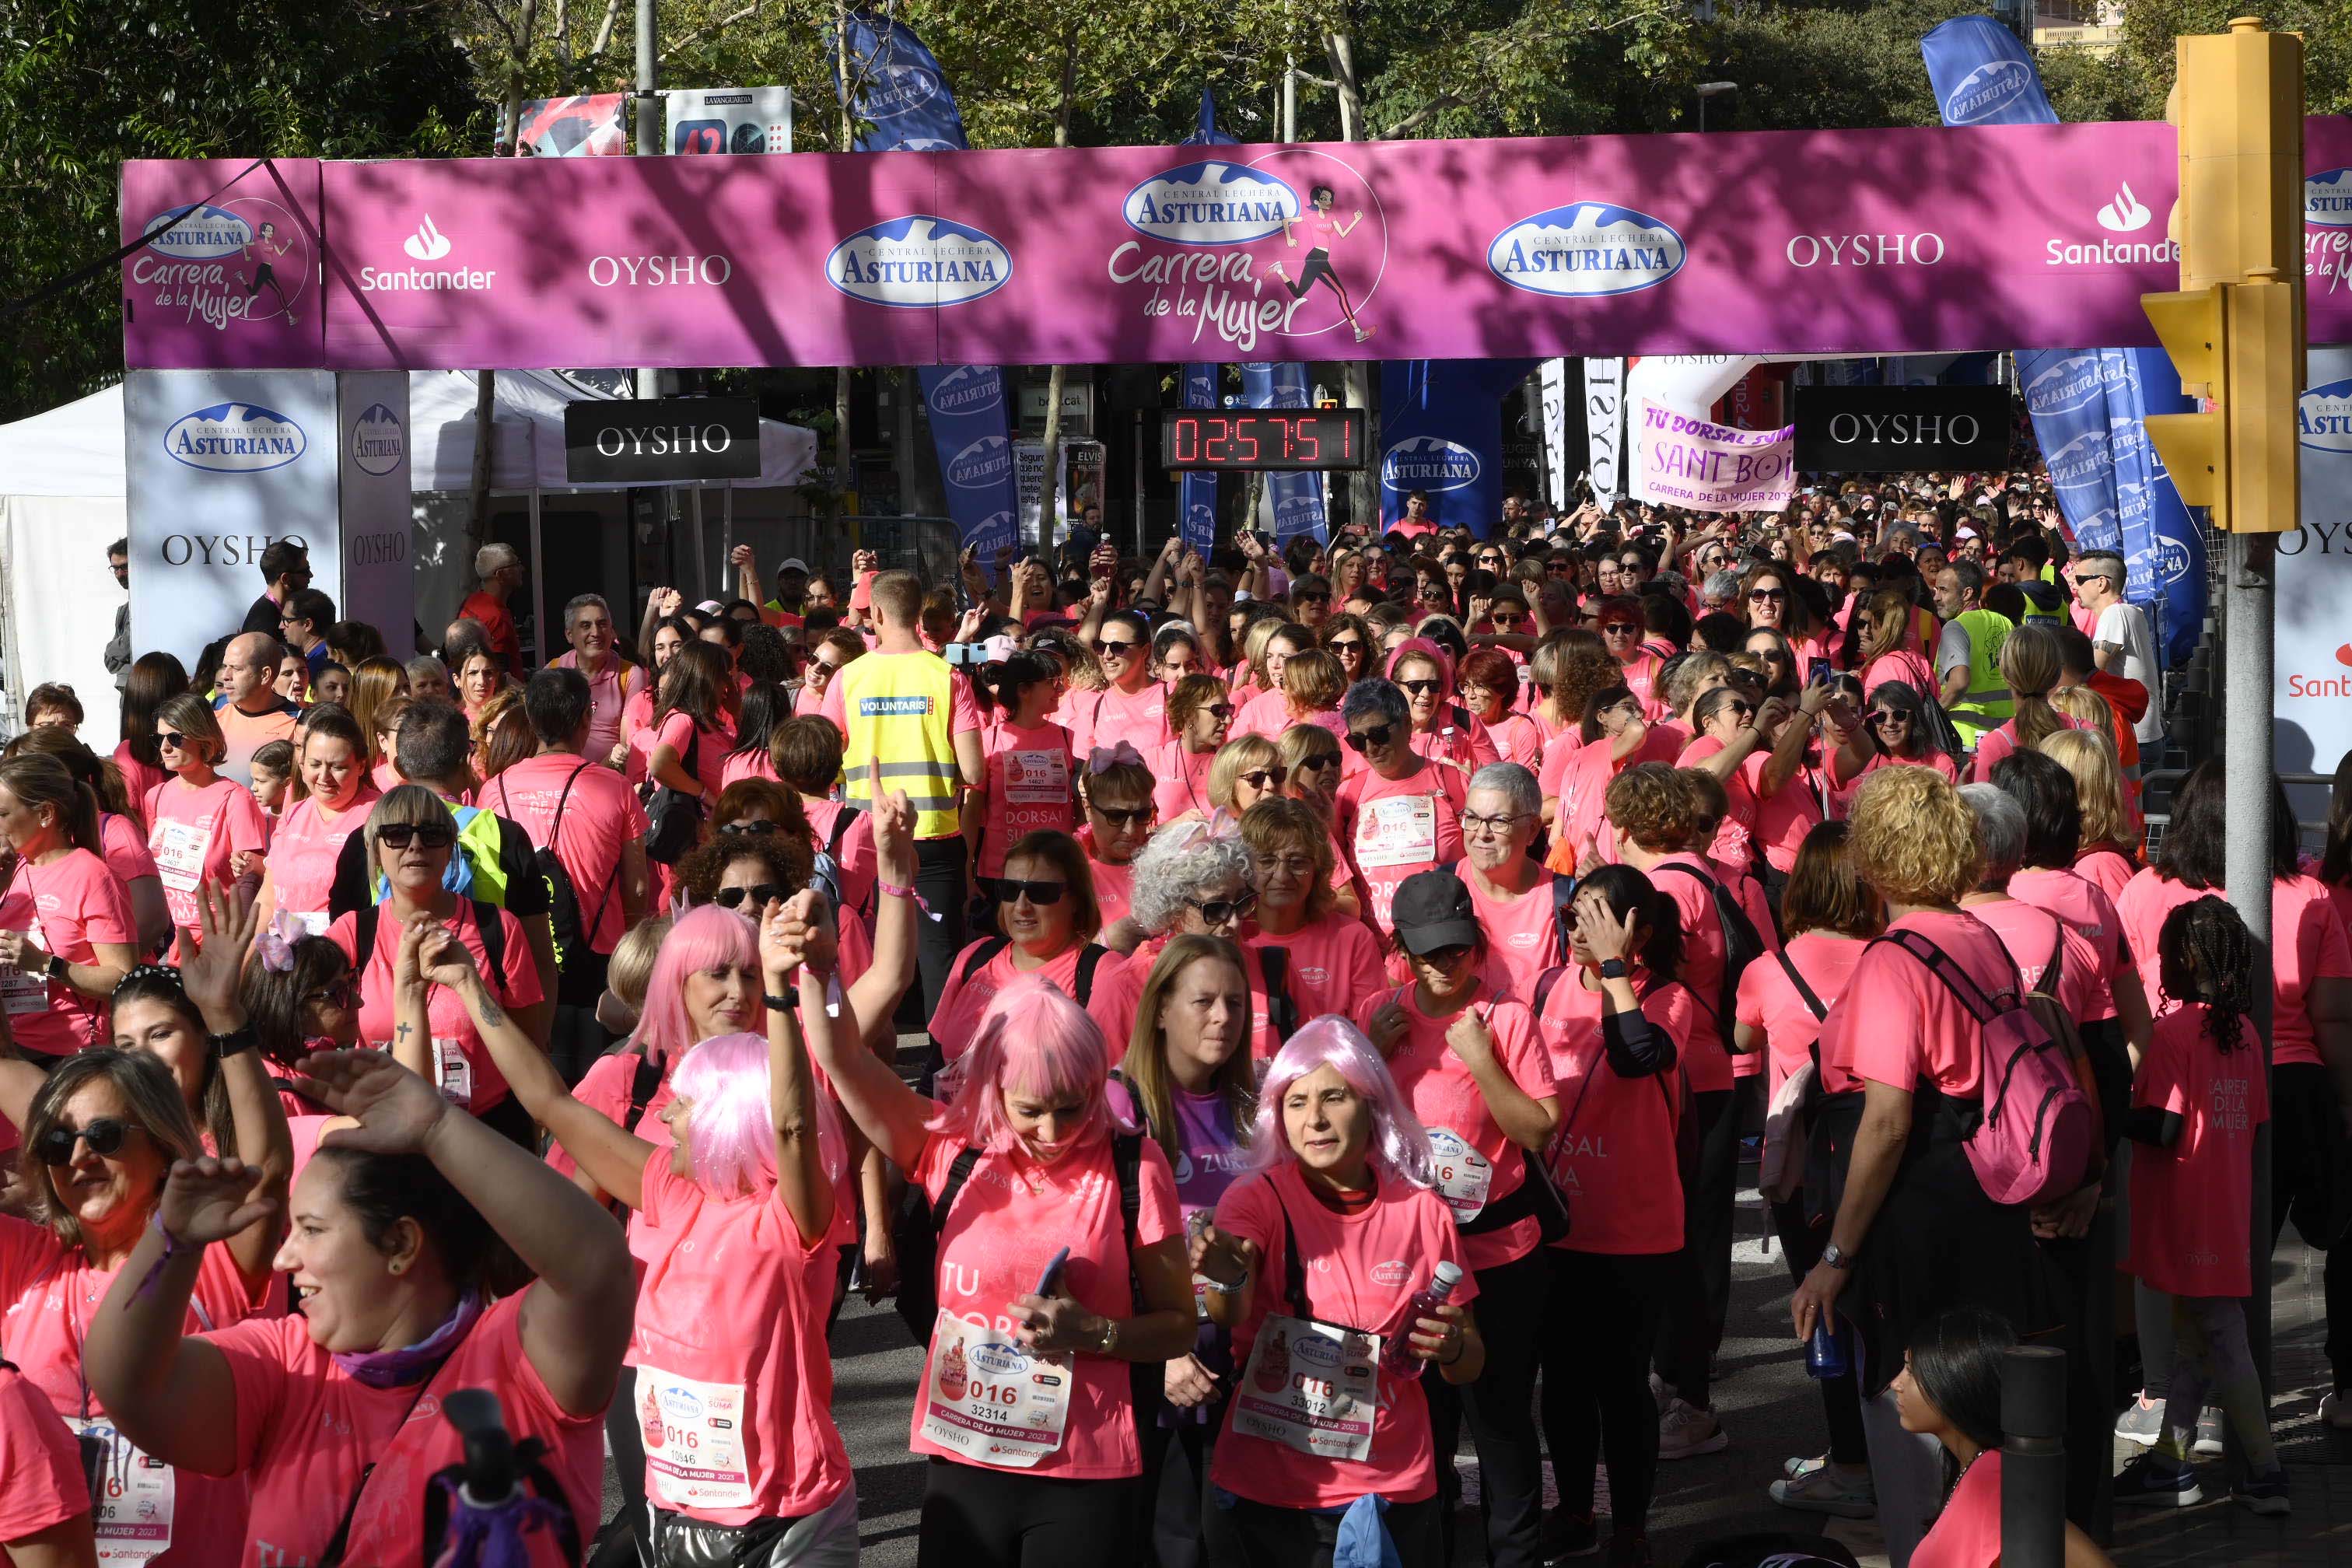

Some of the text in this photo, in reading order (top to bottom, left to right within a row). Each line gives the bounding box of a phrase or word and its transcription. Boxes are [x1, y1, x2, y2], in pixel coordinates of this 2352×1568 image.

[714, 95, 751, 104] VANGUARDIA
[1164, 187, 1281, 199] CENTRAL LECHERA
[1136, 194, 1284, 226] ASTURIANA
[152, 224, 243, 245] ASTURIANA
[1533, 233, 1664, 245] CENTRAL LECHERA
[869, 245, 992, 257] CENTRAL LECHERA
[1503, 237, 1671, 273] ASTURIANA
[1787, 233, 1944, 267] OYSHO
[2046, 238, 2181, 265] Santande
[132, 256, 223, 285] Carrera
[588, 255, 731, 287] OYSHO
[840, 256, 998, 284] ASTURIANA
[1108, 240, 1252, 284] Carrera
[2319, 254, 2332, 276] la
[361, 265, 496, 292] Santander
[156, 282, 259, 331] de la Mujer
[1143, 279, 1307, 352] de la Mujer
[1646, 408, 1669, 429] TU
[1671, 415, 1745, 445] DORSAL
[1829, 413, 1979, 445] OYSHO
[175, 429, 296, 456] ASTURIANA
[355, 432, 401, 457] ASTURIANA
[596, 424, 730, 456] OYSHO
[1176, 418, 1349, 460] 02:57:51
[1078, 452, 1101, 462] ELVIS
[1651, 441, 1728, 482] SANT
[1020, 464, 1032, 474] que
[1385, 459, 1472, 480] ASTURIANA
[1020, 495, 1034, 504] este
[1649, 481, 1793, 502] CARRERA DE LA MUJER 2023
[162, 534, 308, 567] OYSH
[353, 530, 404, 566] OYSHO
[861, 701, 926, 712] VOLUNTARIS
[163, 846, 183, 859] 016
[944, 1262, 979, 1297] TU
[972, 1349, 1024, 1371] ASTURIANA
[970, 1380, 1018, 1405] 016
[1292, 1372, 1334, 1399] 016
[664, 1395, 699, 1414] ASTURIANA
[708, 1400, 733, 1410] SUMA
[971, 1404, 1008, 1423] 32314
[1291, 1395, 1327, 1414] 33012
[940, 1409, 1047, 1440] CARRERA DE LA MUJER 2023
[1246, 1417, 1286, 1436] OYSHO
[1253, 1402, 1290, 1418] CARRERA
[1313, 1416, 1339, 1430] MUJER
[1341, 1423, 1360, 1431] 2023
[667, 1425, 698, 1449] 016
[933, 1424, 970, 1446] OYSHO
[1318, 1437, 1359, 1449] Santander
[671, 1449, 696, 1465] 10946
[1001, 1444, 1043, 1459] Santande
[649, 1458, 672, 1472] CARRERA
[672, 1466, 679, 1475] DE
[679, 1468, 688, 1477] LA
[689, 1470, 716, 1479] MUJER
[699, 1487, 740, 1498] Santander
[104, 1527, 135, 1536] MUJER
[138, 1528, 156, 1536] 2023
